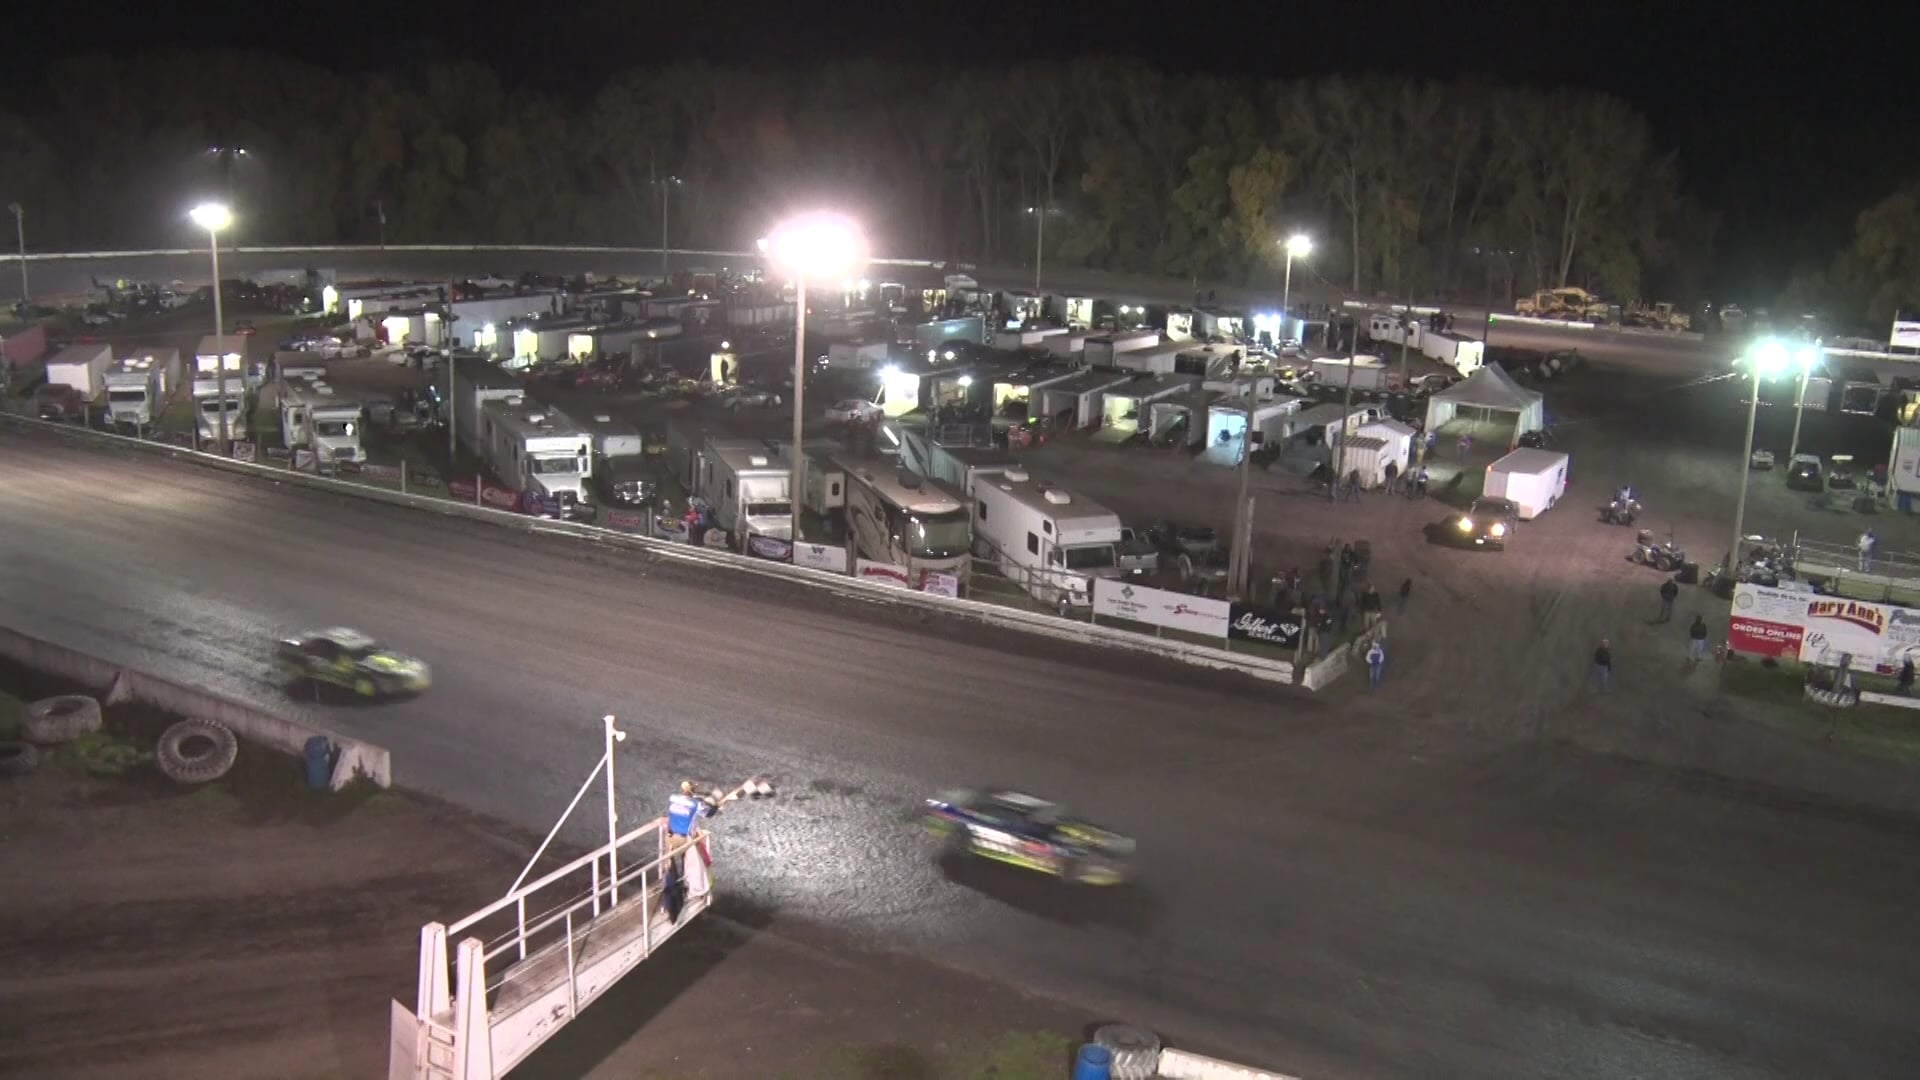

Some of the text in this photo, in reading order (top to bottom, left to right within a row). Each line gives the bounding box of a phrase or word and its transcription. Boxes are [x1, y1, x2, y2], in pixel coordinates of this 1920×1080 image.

[1808, 602, 1844, 615] Mary
[1847, 602, 1884, 626] Ann's
[1732, 623, 1765, 634] ORDER
[1766, 629, 1802, 640] ONLINE
